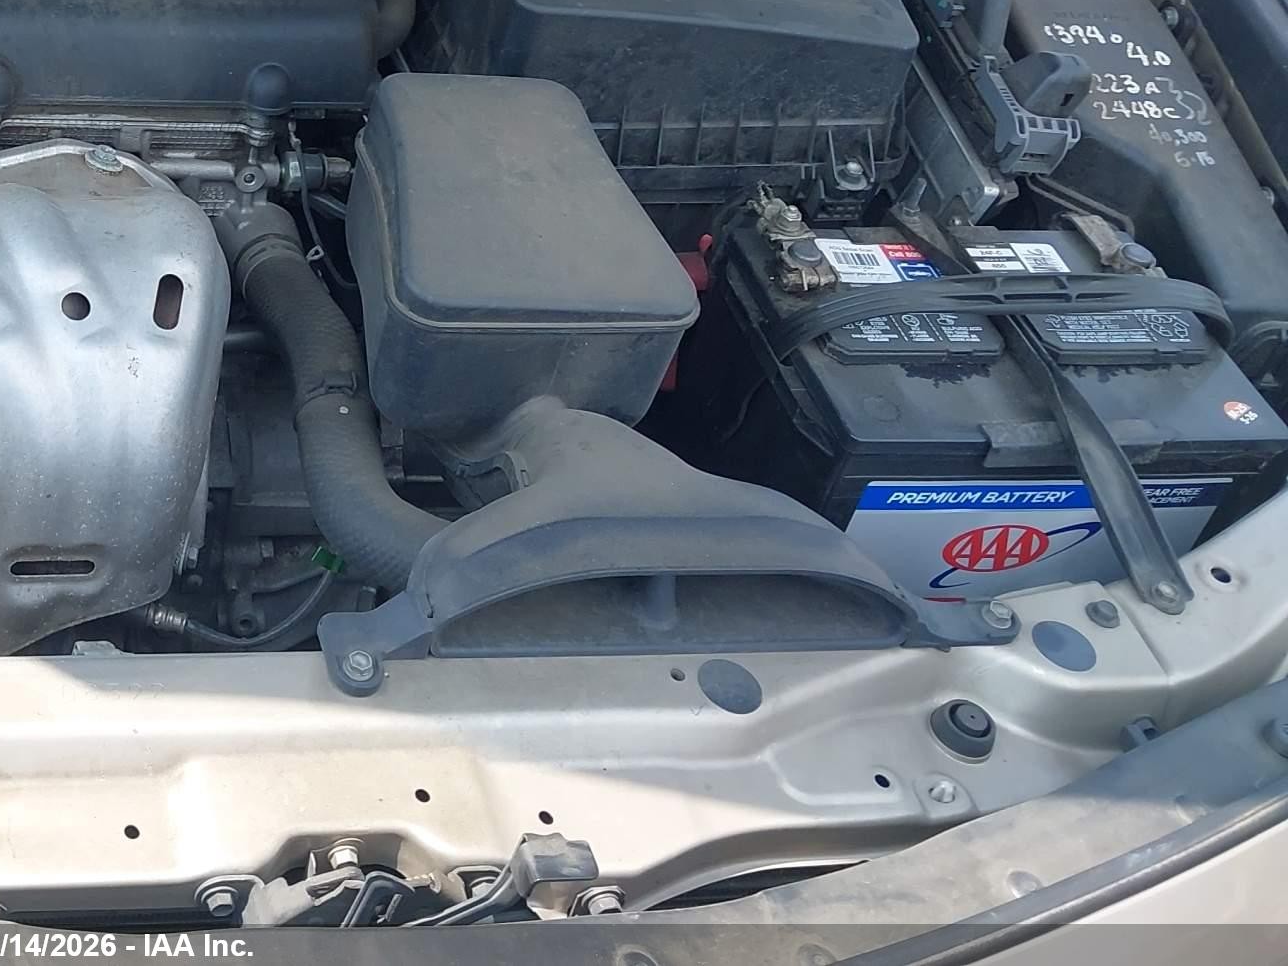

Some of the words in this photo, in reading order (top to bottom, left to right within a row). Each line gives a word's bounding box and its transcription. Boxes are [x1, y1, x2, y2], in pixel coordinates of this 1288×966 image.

[887, 491, 983, 505] PREMIUM
[984, 490, 1076, 504] BATTERY
[1143, 488, 1171, 497] EAR
[1169, 487, 1205, 496] FREE
[1149, 496, 1197, 504] ACEMENT
[950, 525, 1045, 572] AAA
